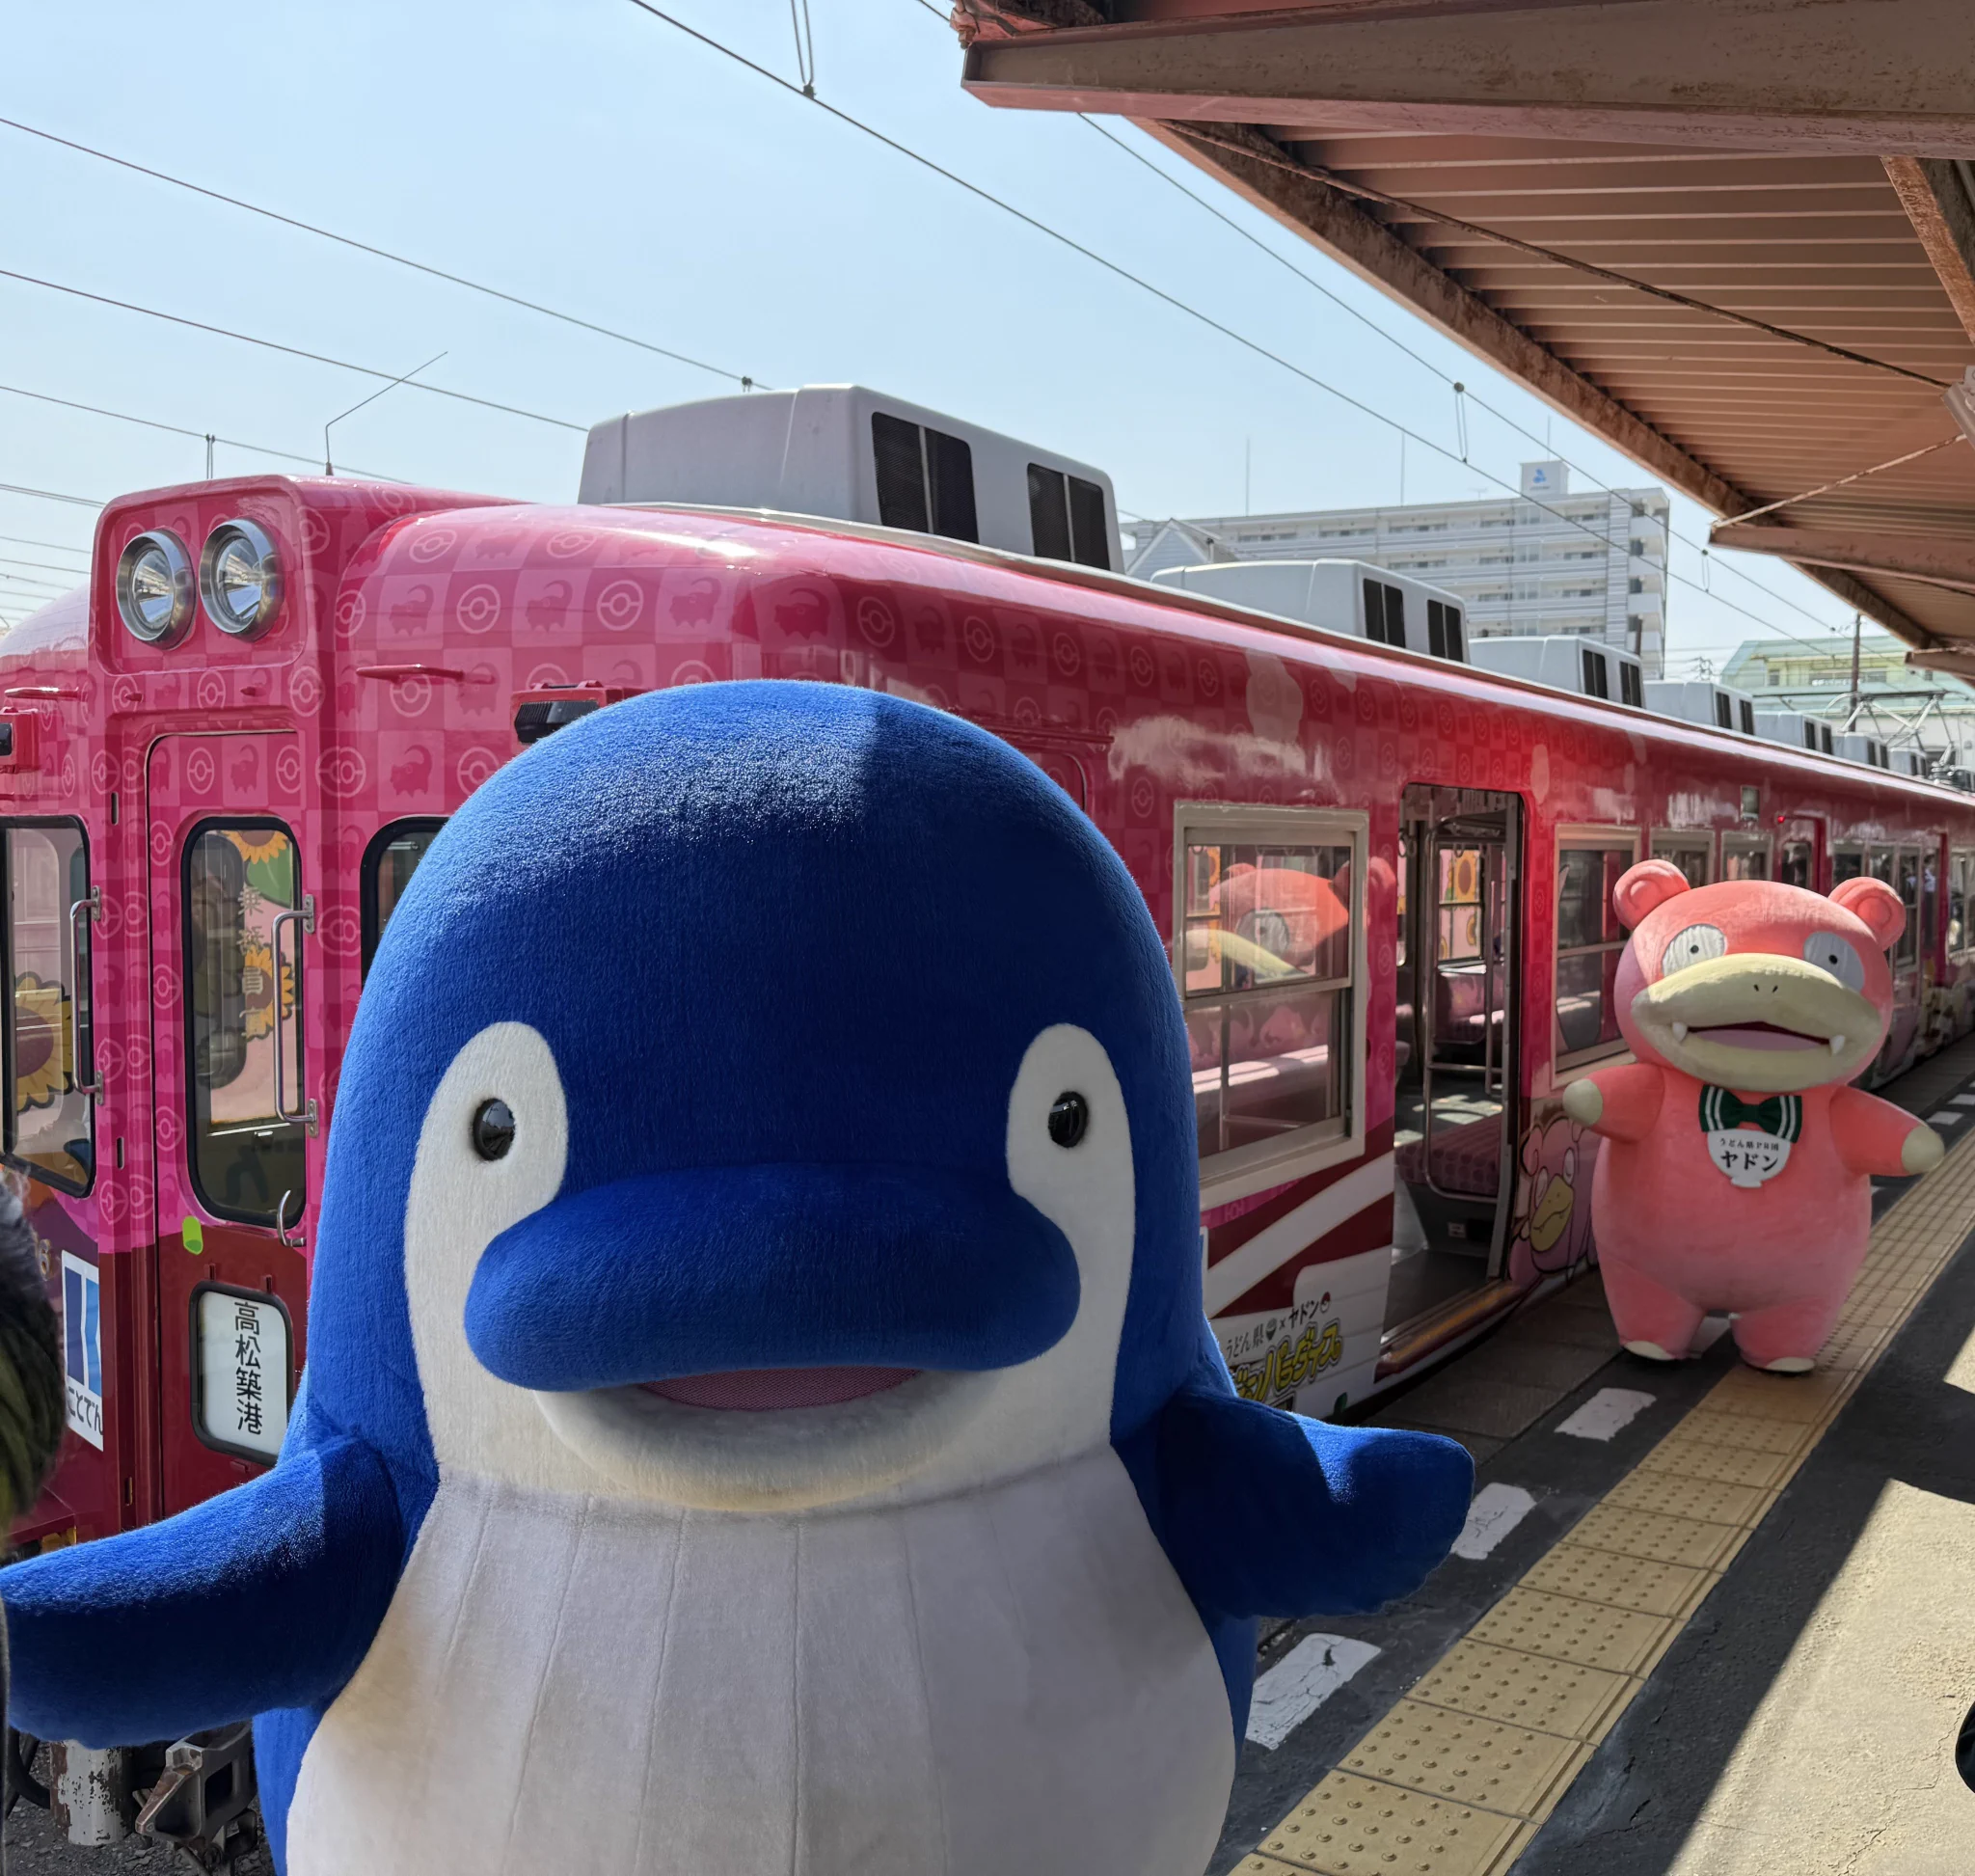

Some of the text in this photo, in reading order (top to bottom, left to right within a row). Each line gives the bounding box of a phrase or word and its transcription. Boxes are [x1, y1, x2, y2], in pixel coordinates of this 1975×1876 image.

[1720, 1151, 1778, 1172] ヤドン
[234, 1302, 263, 1435] 高松築港
